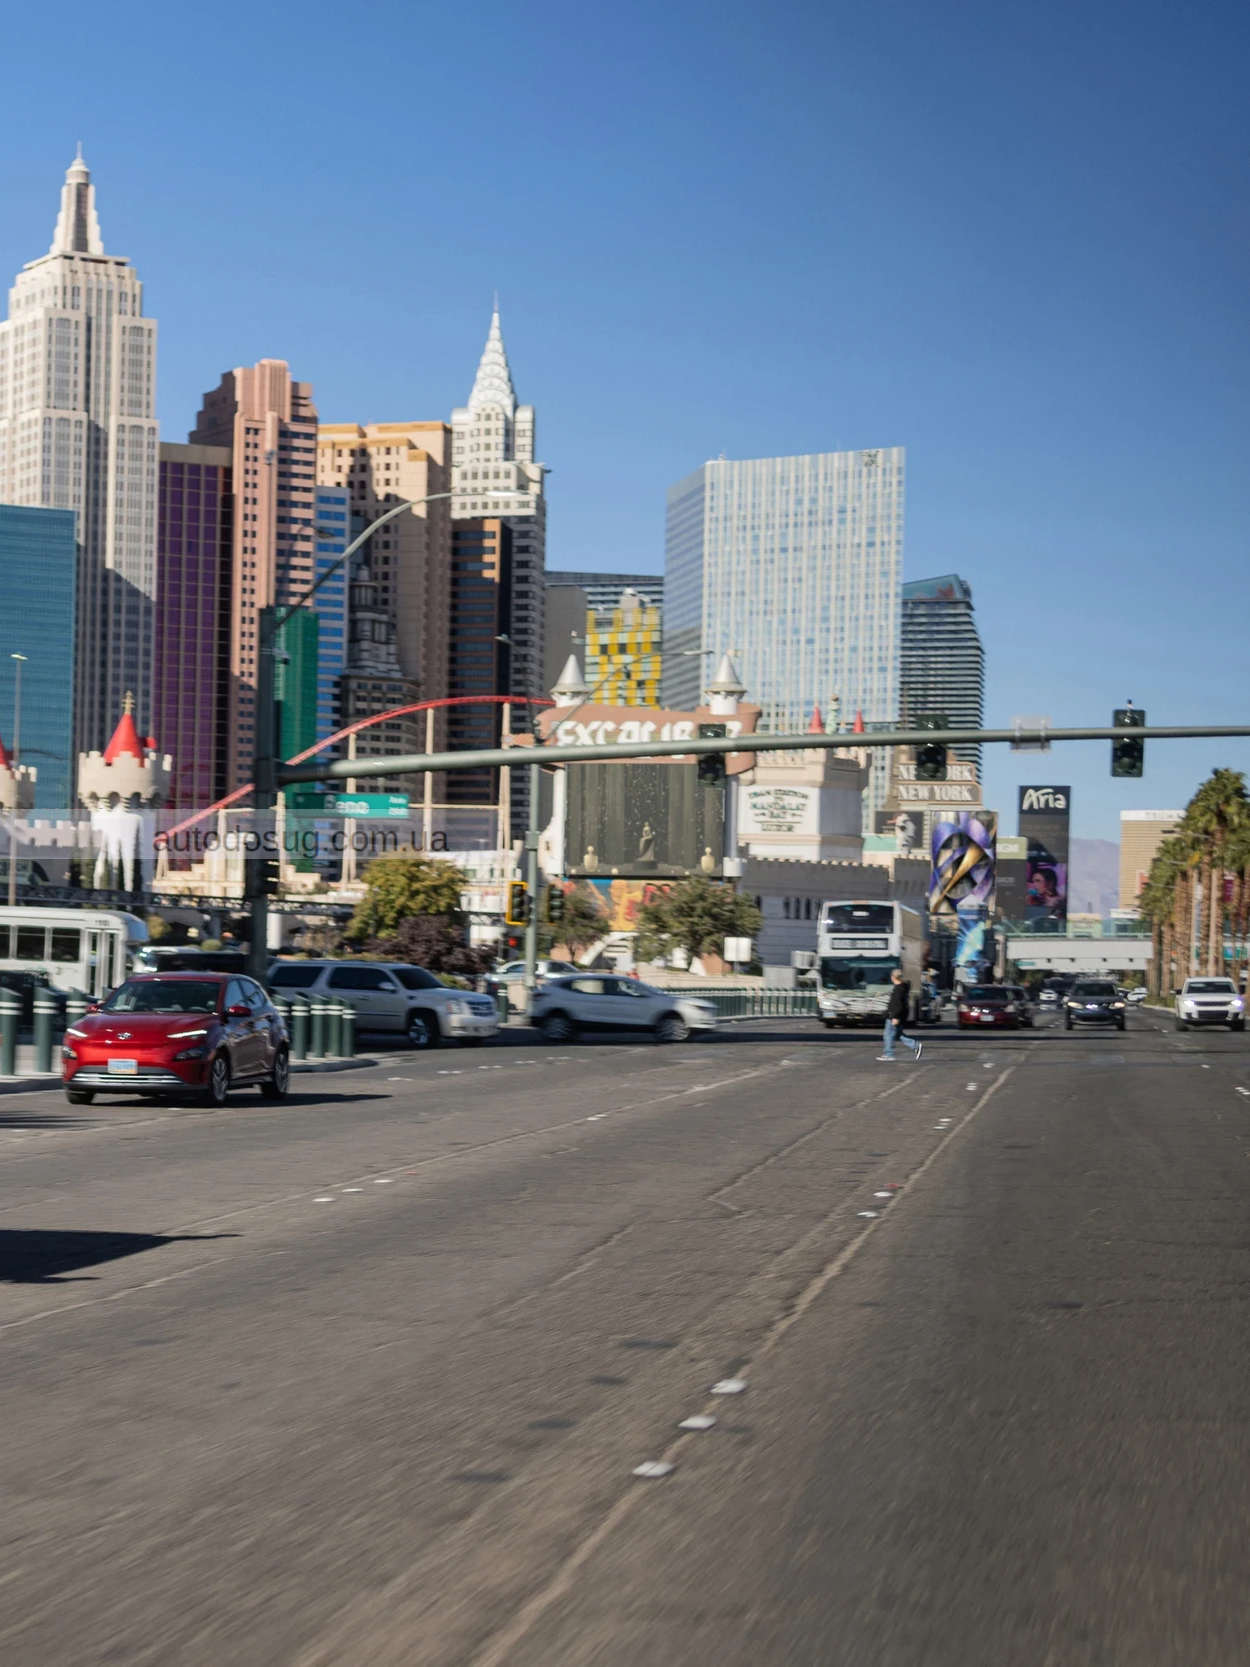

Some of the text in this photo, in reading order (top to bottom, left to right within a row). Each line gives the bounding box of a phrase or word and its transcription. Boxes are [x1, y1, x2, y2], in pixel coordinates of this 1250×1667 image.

[557, 720, 742, 758] EXCALIB
[898, 765, 918, 780] NE
[898, 784, 973, 801] NEW YORK
[1021, 788, 1067, 811] Aria
